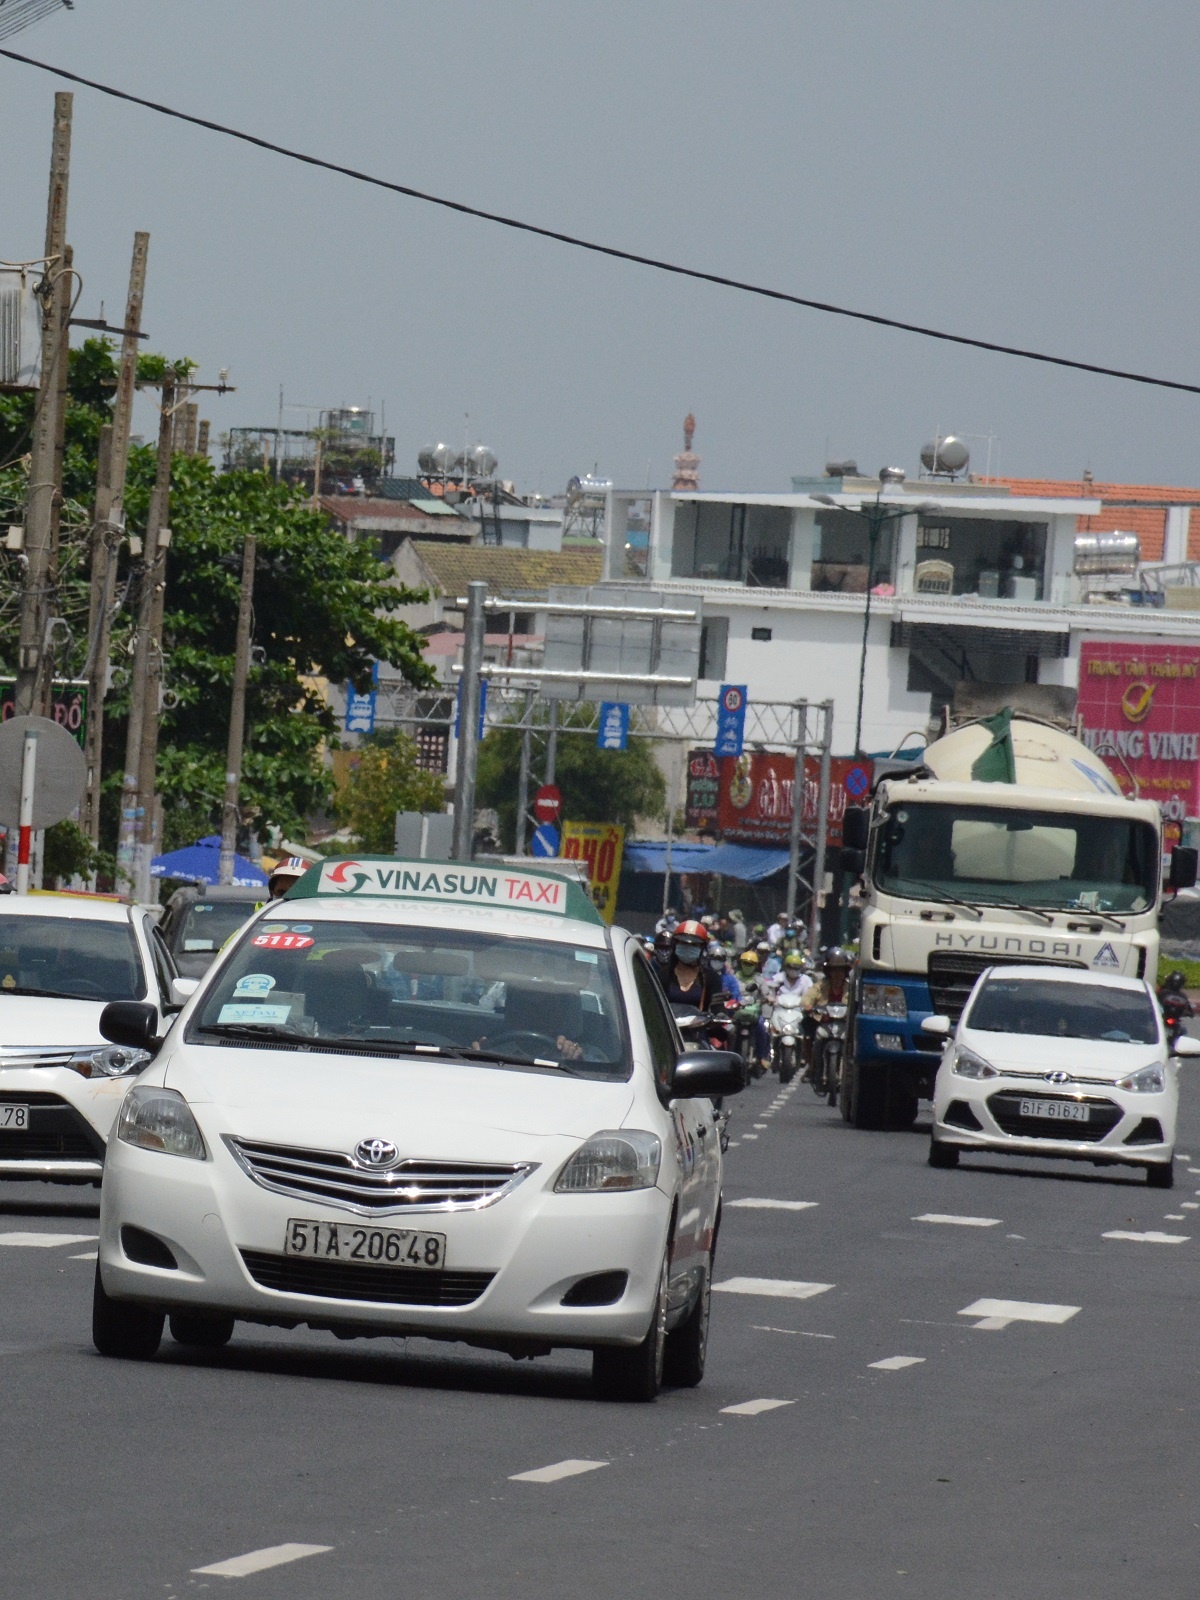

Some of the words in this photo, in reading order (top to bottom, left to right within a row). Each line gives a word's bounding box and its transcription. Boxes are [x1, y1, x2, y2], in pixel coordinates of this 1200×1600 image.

[1148, 731, 1199, 761] VINH
[376, 868, 498, 897] VINASUN
[505, 878, 560, 905] TAXI
[254, 935, 311, 947] 5117
[935, 932, 1082, 957] HYUNDAI
[290, 1223, 440, 1266] 51A-206.48
